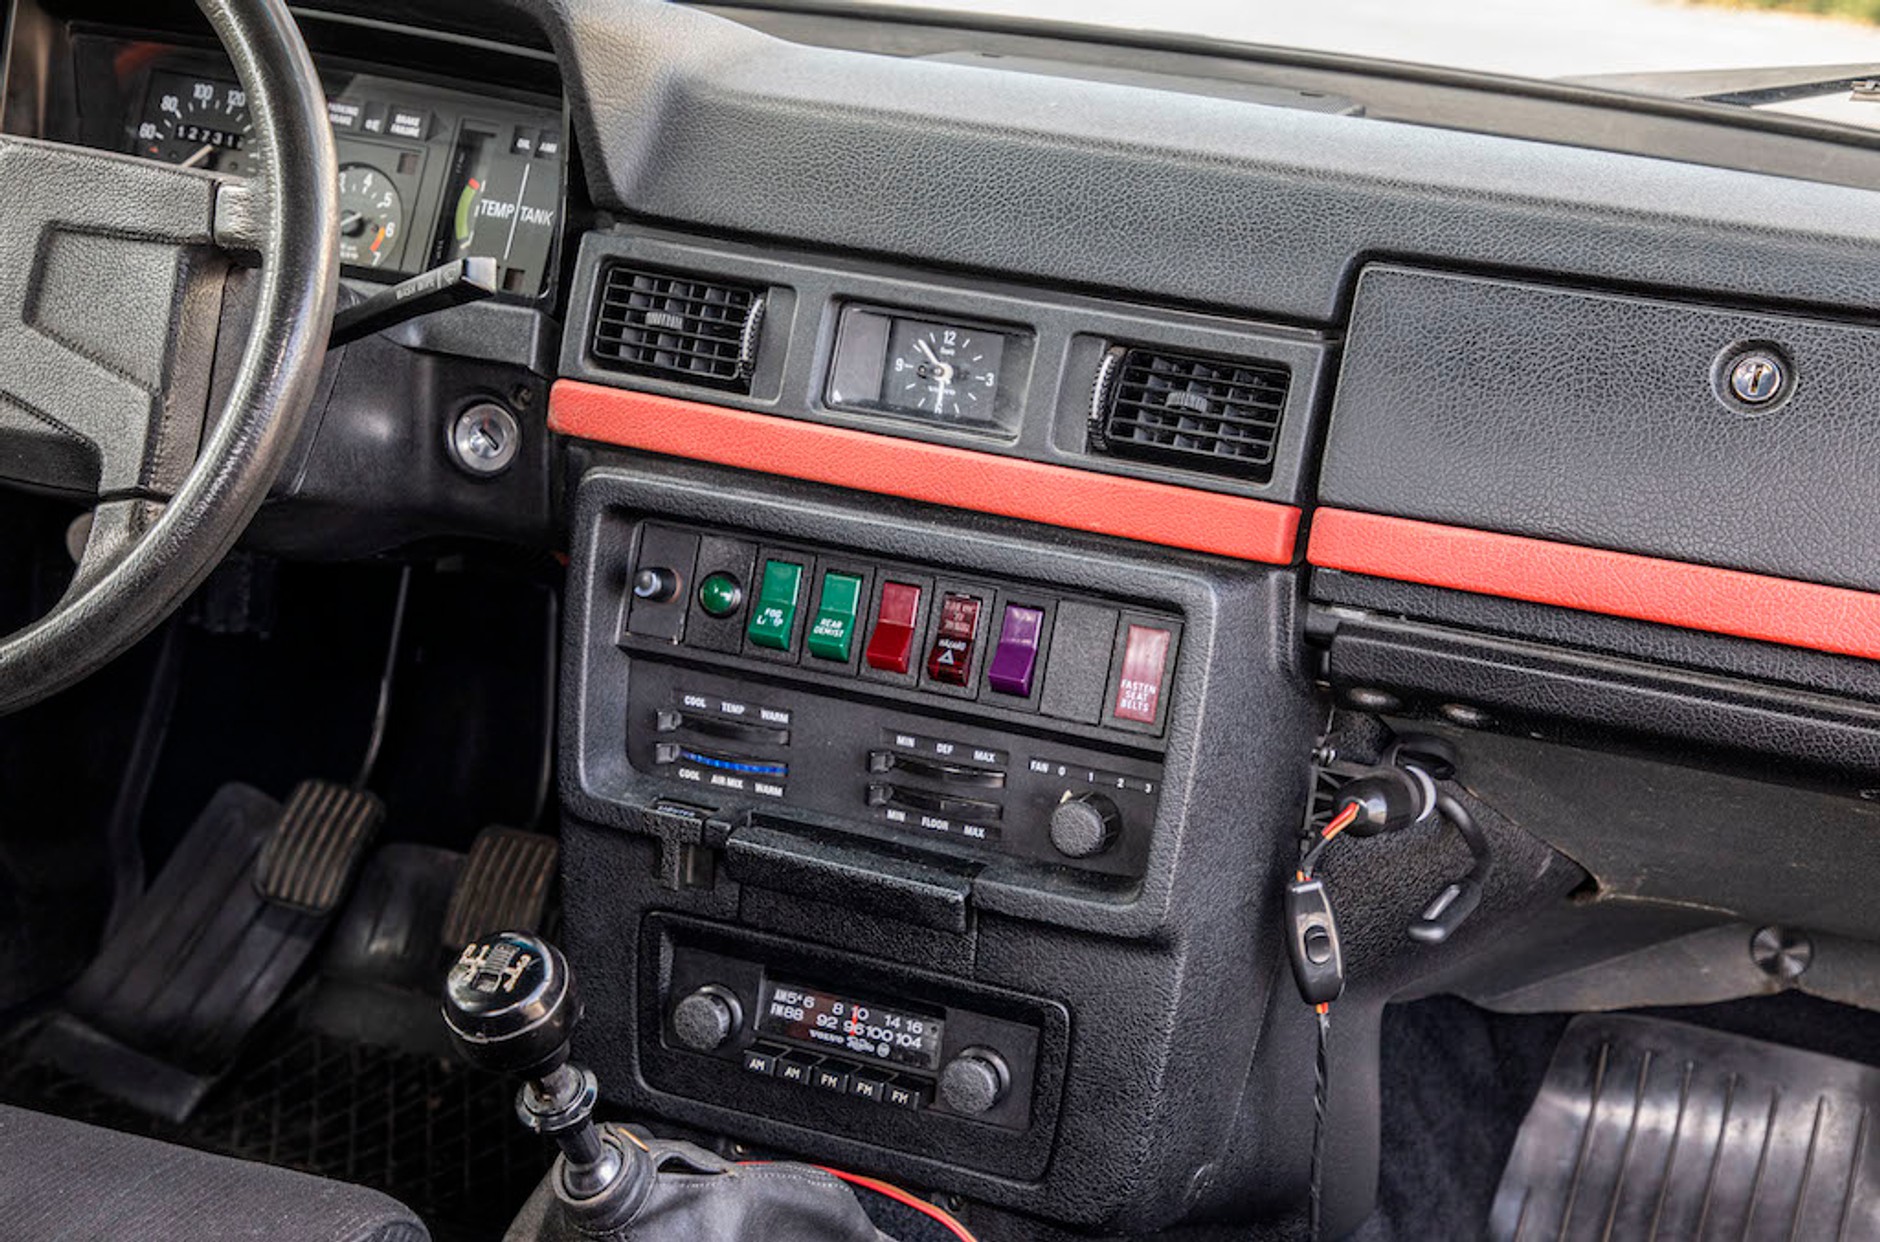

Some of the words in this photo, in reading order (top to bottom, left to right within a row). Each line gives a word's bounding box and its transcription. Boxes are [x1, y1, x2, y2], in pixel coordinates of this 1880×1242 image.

[193, 83, 214, 100] 100
[228, 90, 246, 107] 120
[161, 95, 178, 112] 80
[363, 173, 373, 187] 4
[383, 191, 393, 208] 5
[481, 199, 515, 220] TEMP
[520, 205, 554, 227] TANK
[386, 222, 395, 238] 6
[371, 252, 381, 267] 7
[943, 331, 956, 346] 12
[895, 358, 904, 372] 9
[984, 373, 994, 387] 3
[765, 607, 784, 619] FOG
[820, 618, 843, 629] REAR
[813, 625, 845, 638] DEMIST
[1121, 679, 1157, 695] FASTEN
[1125, 690, 1149, 702] SEAT
[684, 695, 706, 708] COOL
[721, 701, 745, 715] TEMP
[760, 708, 789, 724] WARM
[1120, 698, 1150, 712] BELTS
[896, 735, 915, 748] MIN
[936, 743, 954, 755] DEF
[973, 750, 996, 763] MAX
[678, 768, 700, 781] COOL
[711, 774, 726, 786] AIR
[726, 777, 743, 789] MIX
[754, 782, 783, 797] WARM
[1030, 760, 1049, 773] FAN
[1088, 771, 1094, 782] 1
[1116, 777, 1125, 788] 2
[1144, 782, 1152, 793] 3
[886, 809, 906, 822] MIN
[921, 816, 949, 831] FLOOR
[963, 825, 986, 839] MAX
[831, 1002, 844, 1016] 8
[851, 1006, 870, 1021] 10
[884, 1014, 901, 1029] 14
[906, 1020, 924, 1035] 16
[809, 1029, 845, 1043] VOLVO
[816, 1013, 839, 1030] 92
[843, 1020, 865, 1036] 96
[865, 1025, 894, 1043] 100
[896, 1032, 922, 1049] 104
[749, 1058, 766, 1071] AM
[784, 1066, 801, 1079] AM
[821, 1073, 838, 1088] FM
[856, 1082, 874, 1096] FM
[891, 1090, 909, 1105] FM
